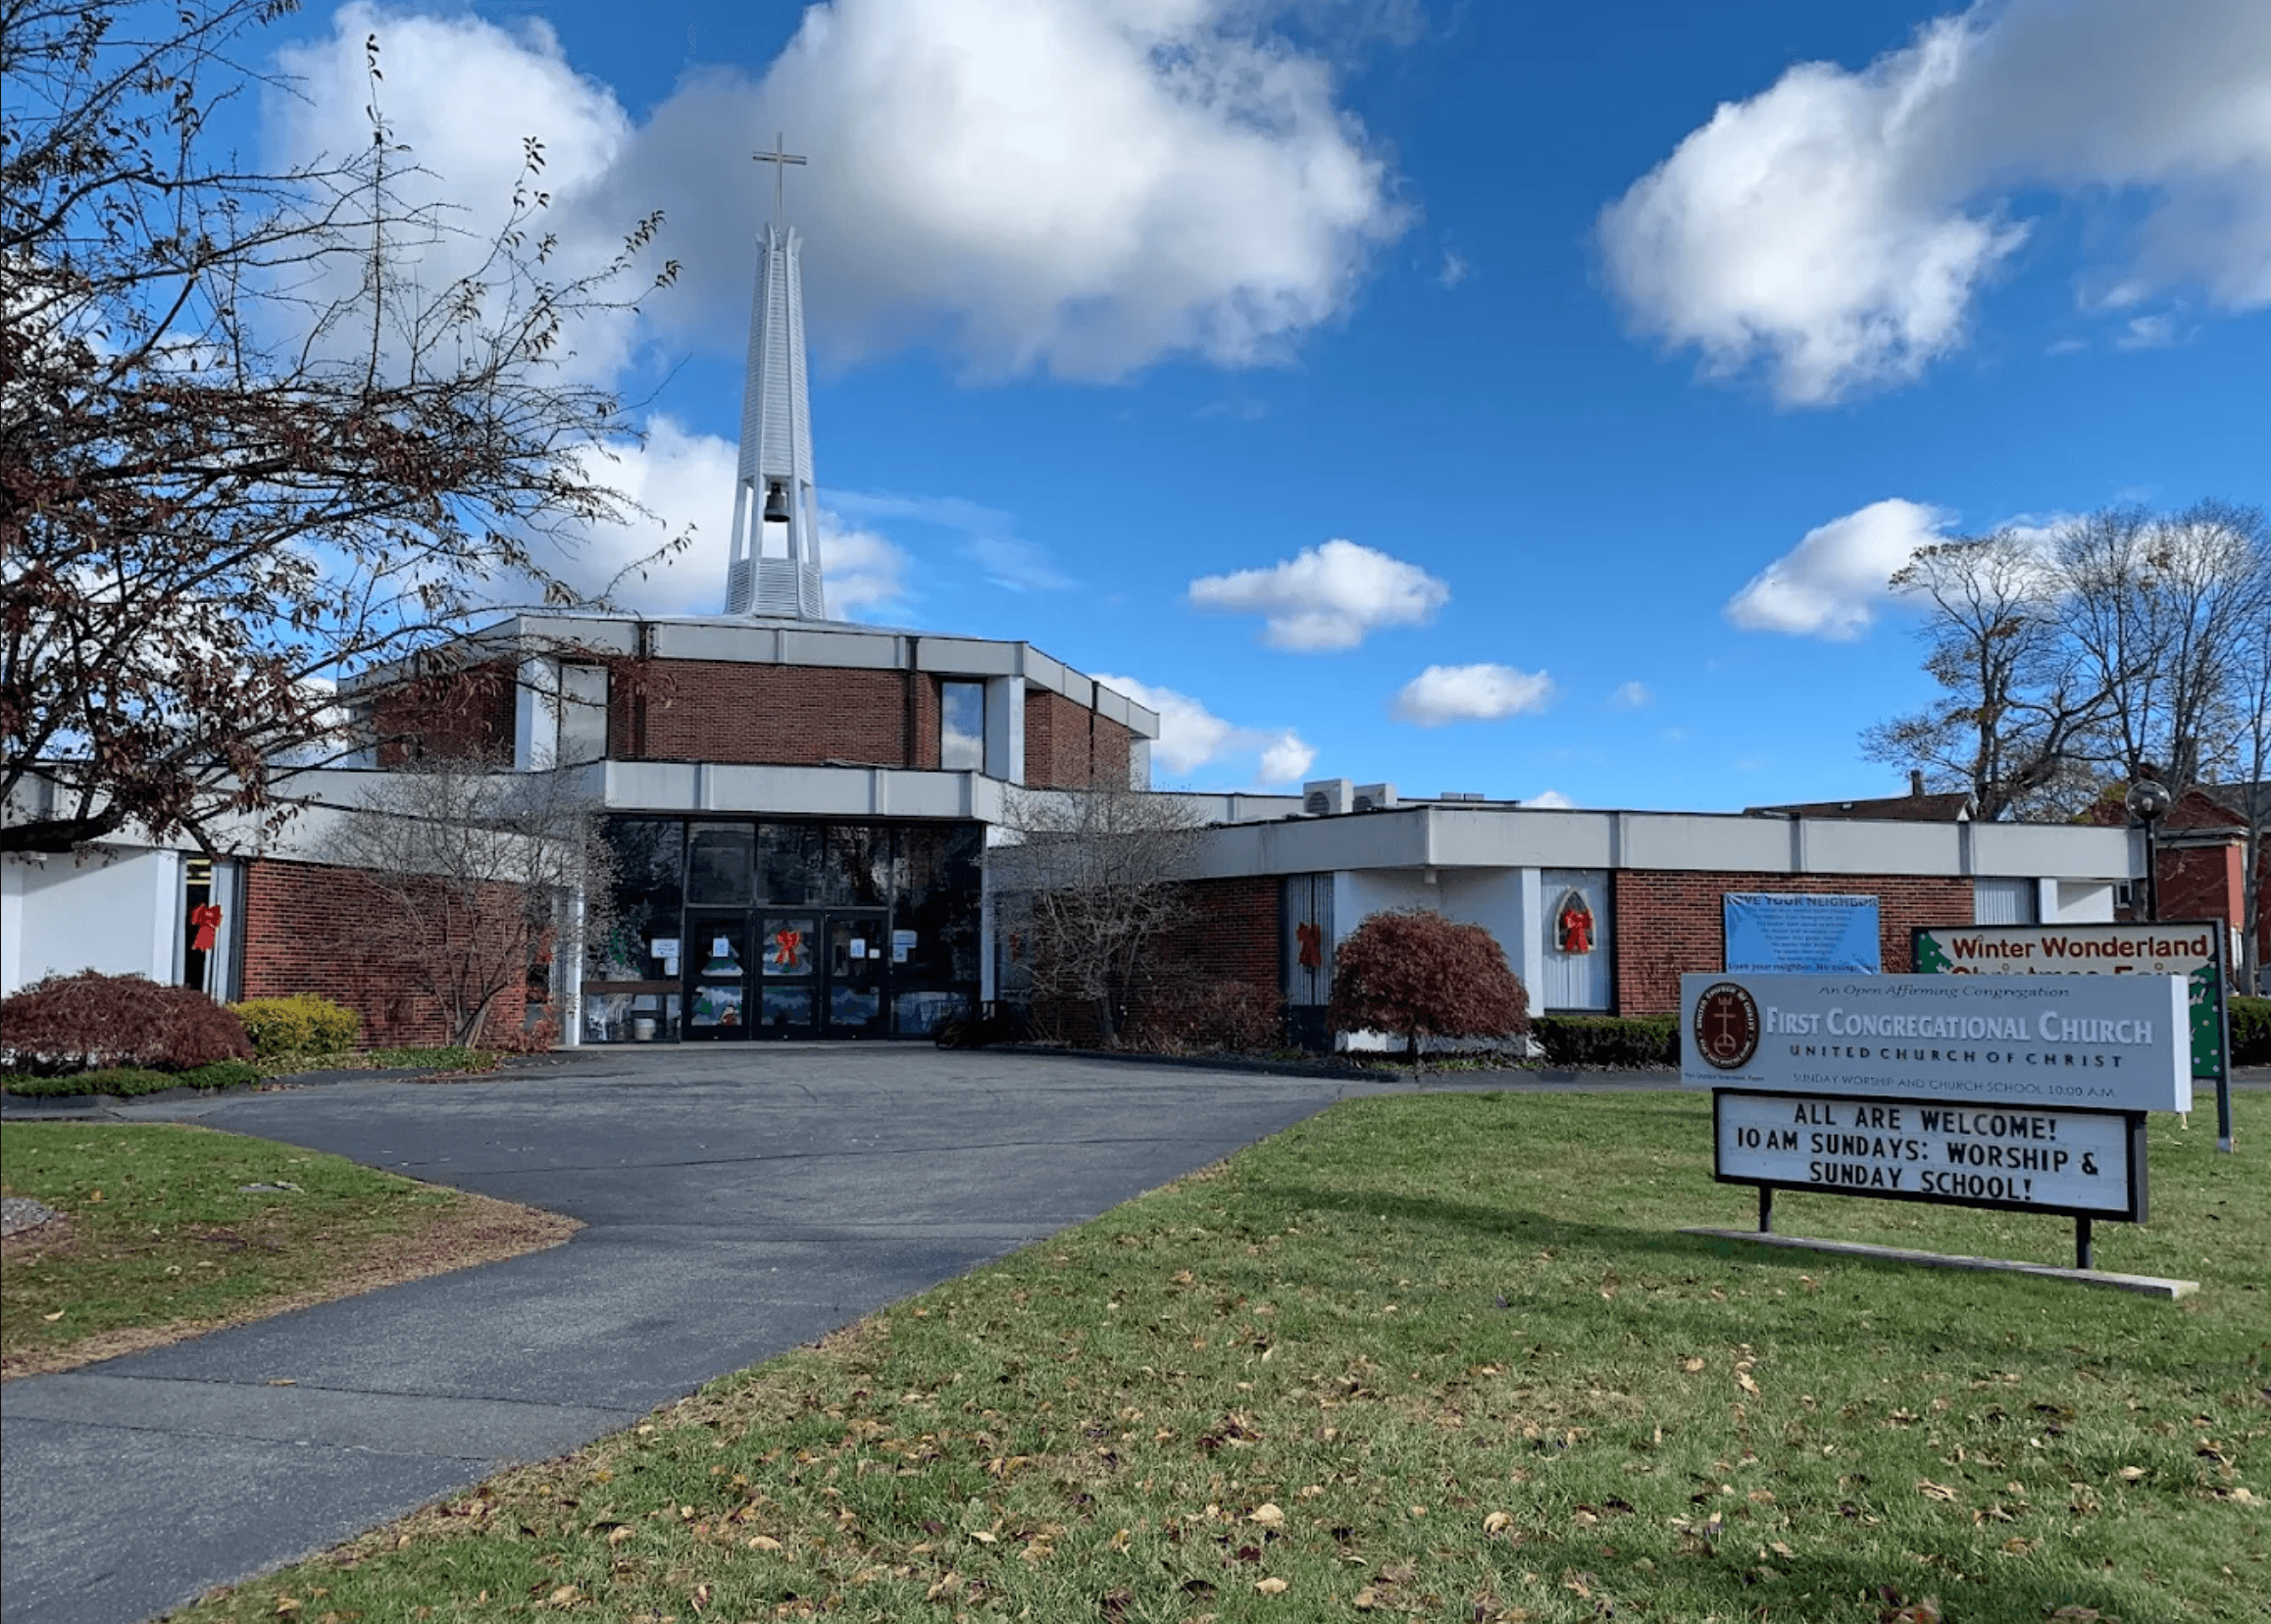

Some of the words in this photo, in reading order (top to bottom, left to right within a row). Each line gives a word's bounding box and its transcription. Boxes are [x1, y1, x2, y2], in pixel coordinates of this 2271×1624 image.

[1952, 935, 2036, 959] Winter
[2042, 935, 2207, 958] Wonderland
[1819, 986, 1839, 995] An
[1844, 986, 1882, 998] Open
[1888, 985, 1958, 999] Affirming
[1962, 986, 2070, 1000] Congregation
[1766, 1007, 1821, 1035] FIRST
[1827, 1007, 2032, 1042] CONGREGATIONAL
[2039, 1010, 2153, 1045] CHURCH
[1790, 1045, 1870, 1059] UNITED
[1881, 1047, 1976, 1062] CHURCH
[1987, 1051, 2014, 1064] OF
[2026, 1053, 2122, 1068] CHRIST
[1792, 1073, 1840, 1086] SUNDAY
[1842, 1074, 1894, 1087] WORSHIP
[1897, 1078, 1926, 1089] AND
[1929, 1080, 1983, 1091] CHURCH
[1987, 1083, 2044, 1094] SCHOOL
[2048, 1085, 2083, 1096] 10:00
[1794, 1103, 1837, 1126] ALL
[1855, 1107, 1901, 1129] ARE
[1921, 1110, 2056, 1141] WELCOME!
[1810, 1133, 1928, 1161] SUNDAYS:
[1946, 1142, 2069, 1172] WORSHIP
[2081, 1152, 2098, 1175] &
[1810, 1161, 1902, 1188] SUNDAY
[1921, 1171, 2032, 1201] SCHOOL!
